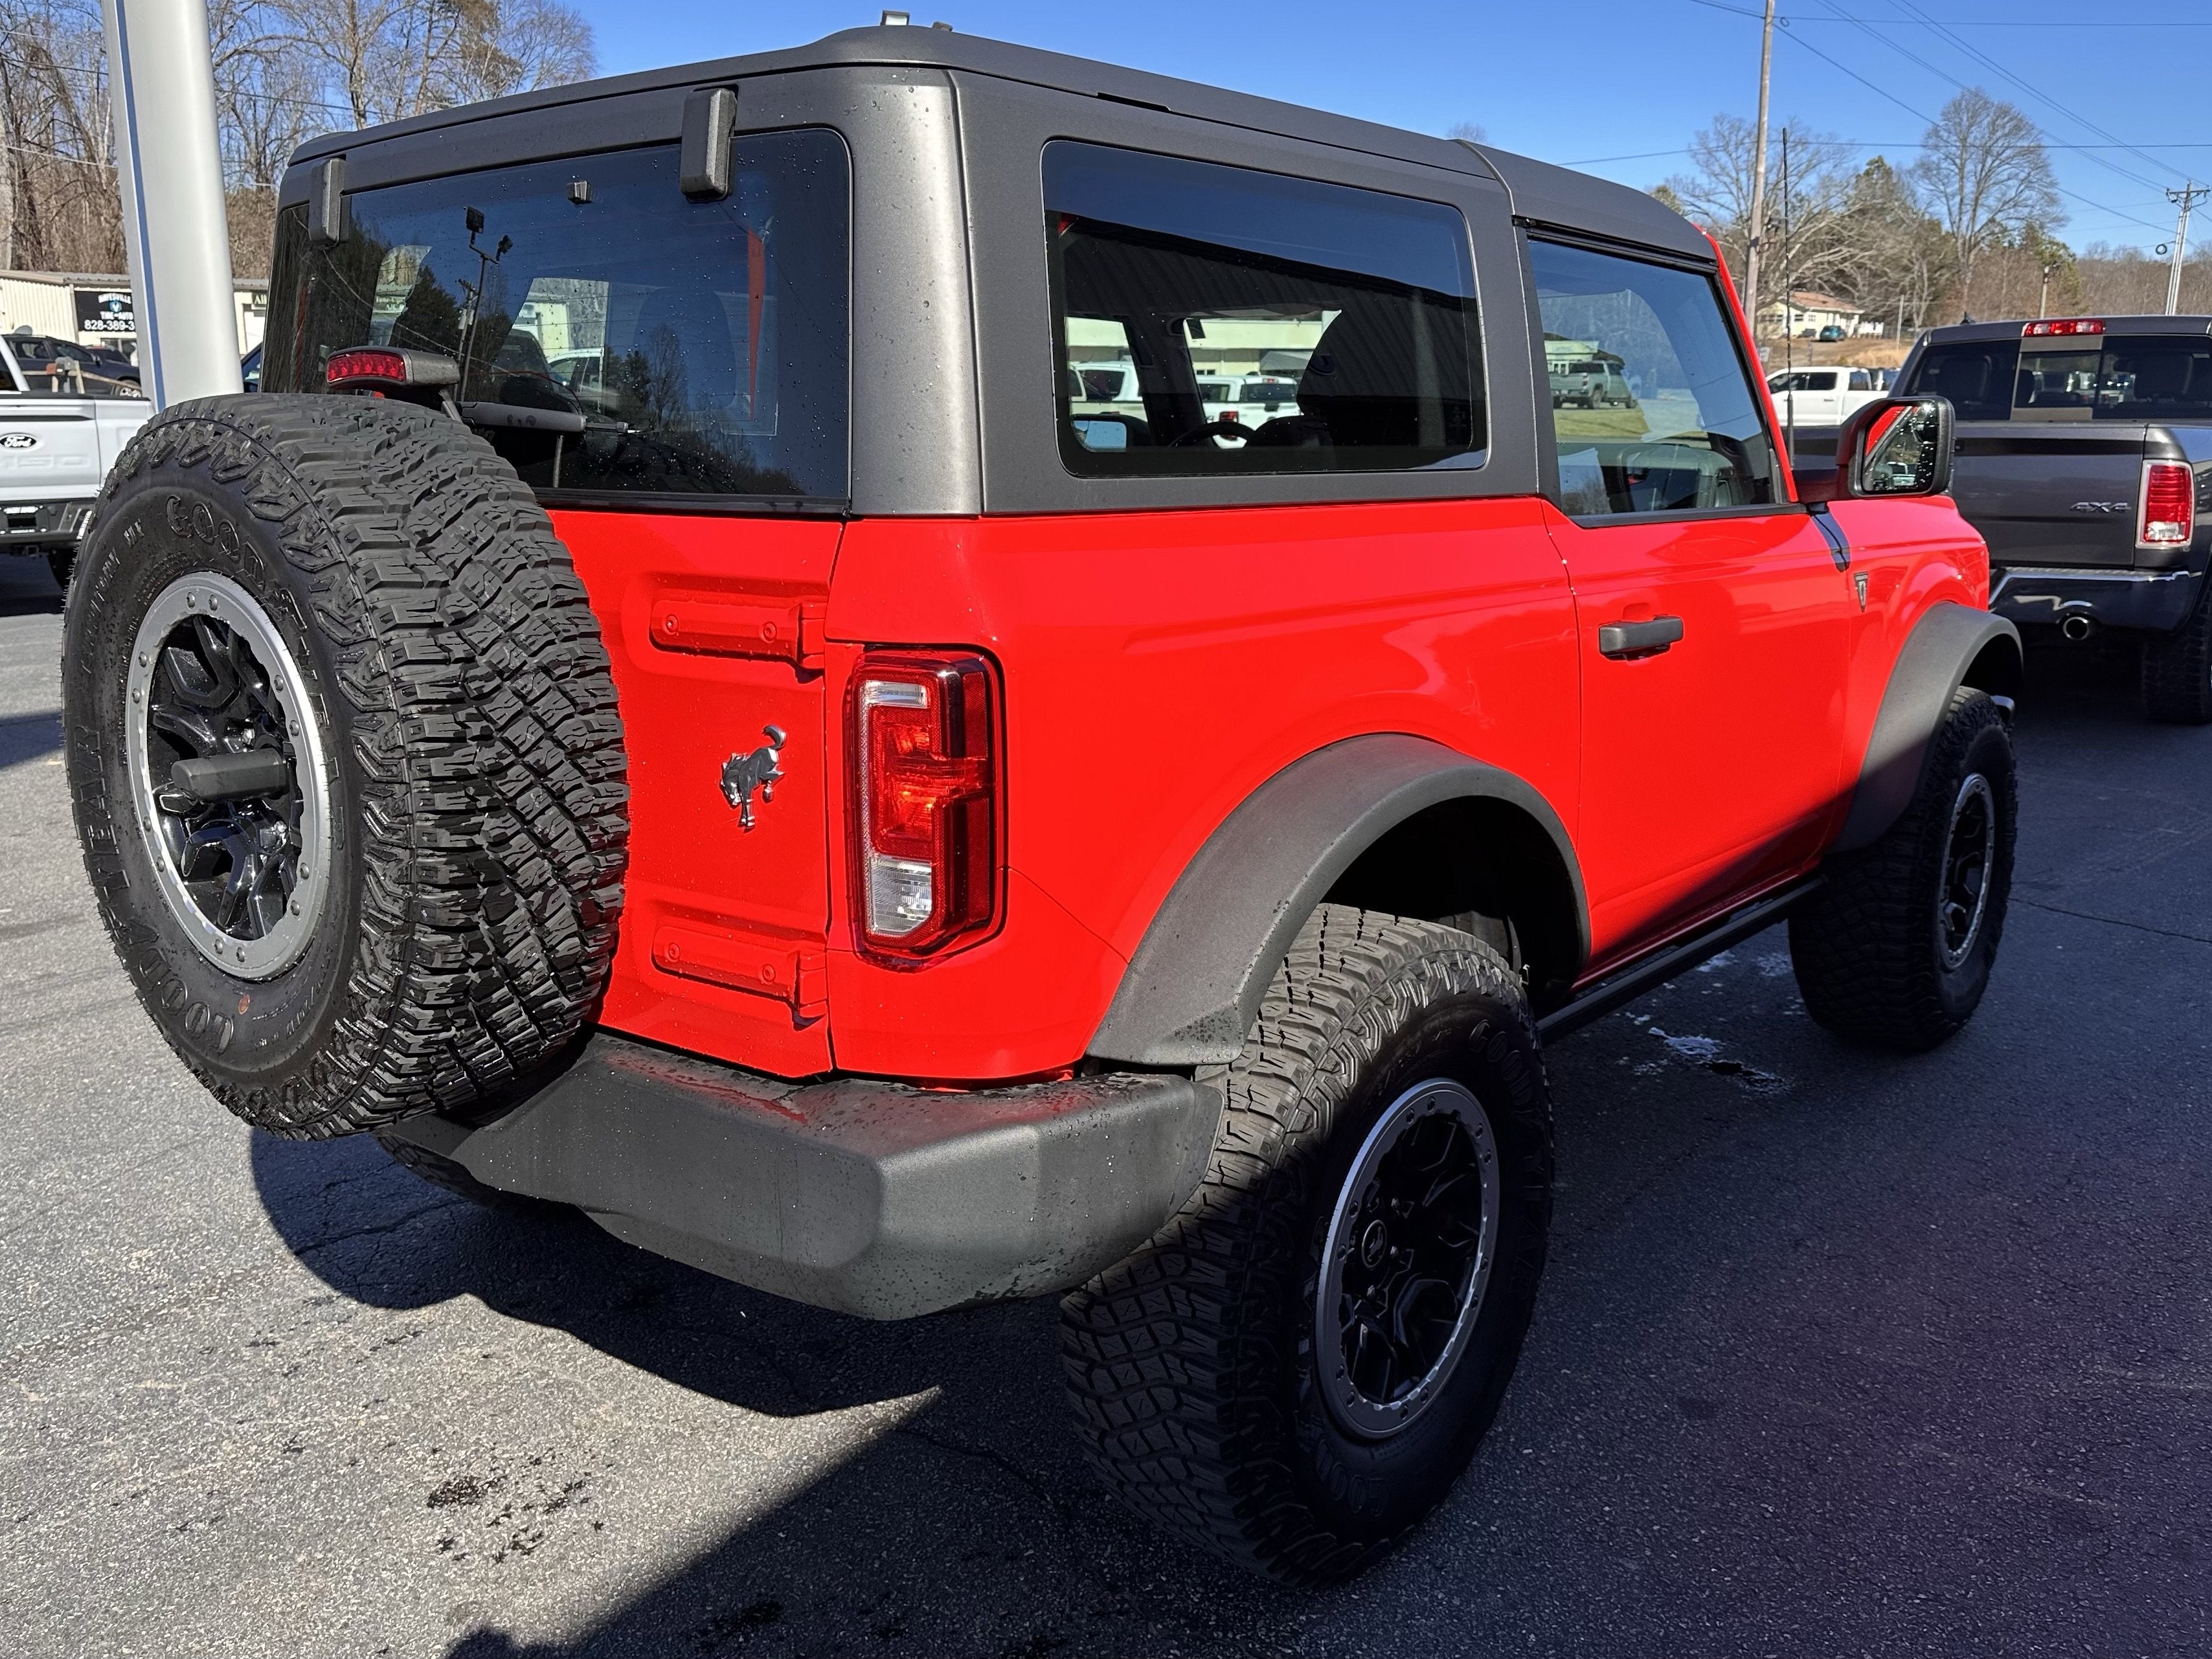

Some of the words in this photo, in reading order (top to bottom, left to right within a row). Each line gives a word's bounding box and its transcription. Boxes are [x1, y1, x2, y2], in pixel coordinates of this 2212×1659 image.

[84, 319, 135, 331] 828-389-3
[4, 436, 32, 447] Ford
[1, 454, 91, 470] 150
